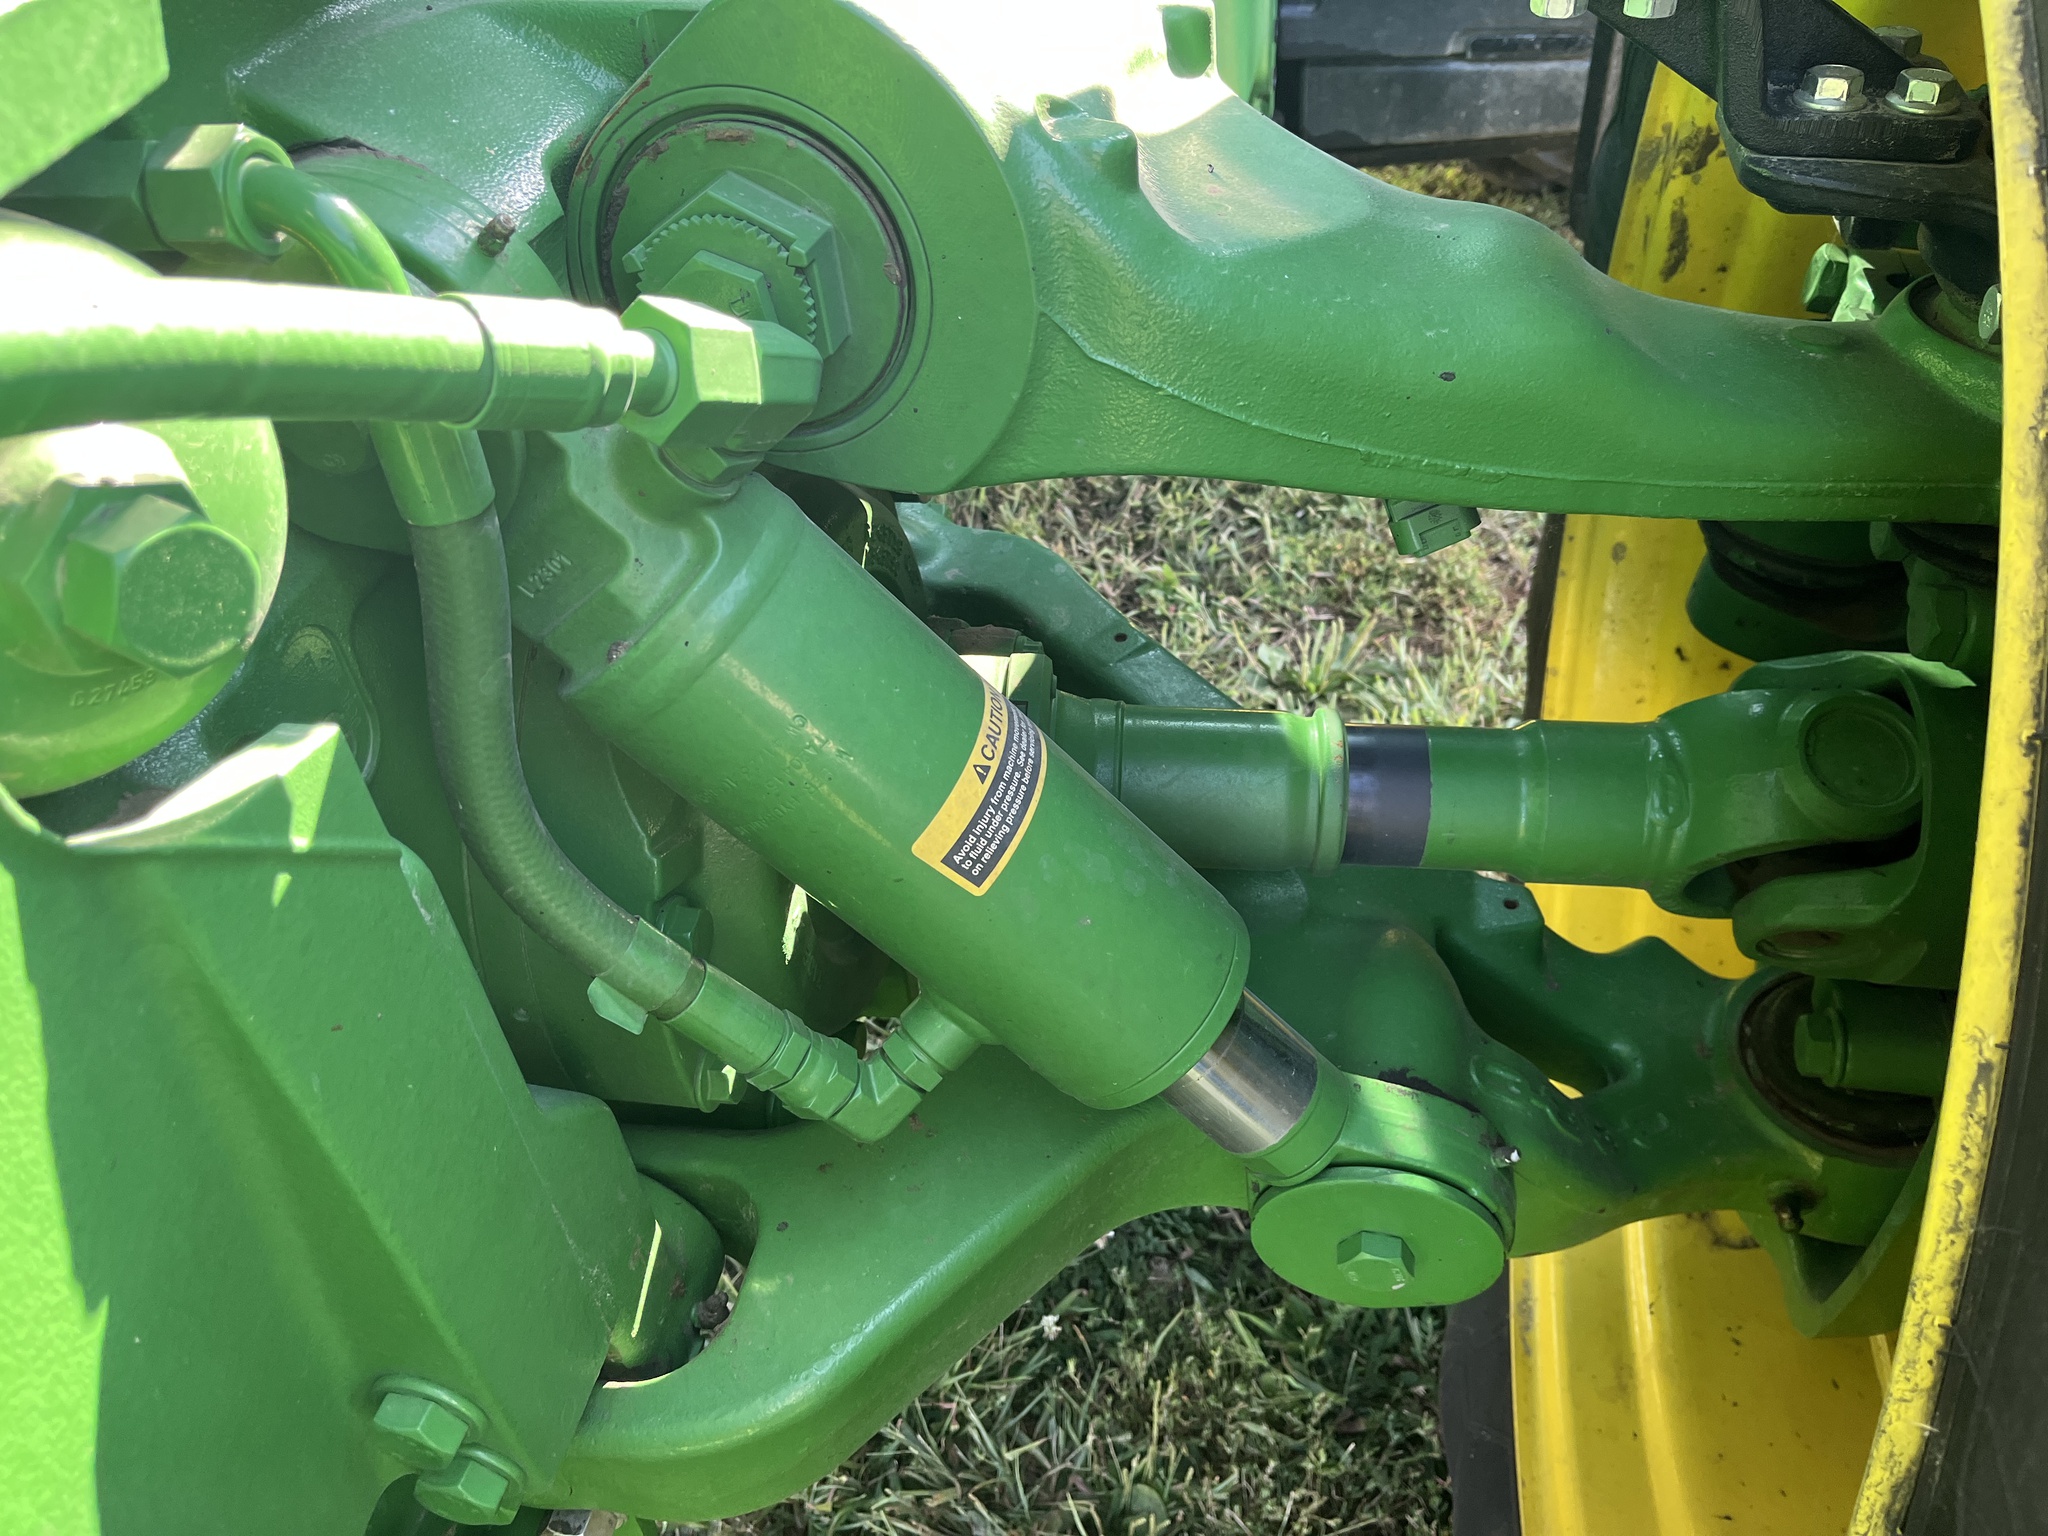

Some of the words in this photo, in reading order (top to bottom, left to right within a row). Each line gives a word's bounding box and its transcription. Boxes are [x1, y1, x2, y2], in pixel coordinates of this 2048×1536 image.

[981, 686, 1004, 762] CAUTION
[953, 834, 977, 865] Avoid
[972, 804, 996, 836] injury
[990, 781, 1007, 806] from
[1002, 742, 1019, 782] machine
[961, 858, 973, 871] to
[968, 837, 988, 860] fluid
[984, 810, 1004, 839] under
[1000, 770, 1022, 813] pressure.
[1016, 751, 1026, 768] See
[971, 862, 984, 877] on
[980, 823, 1011, 864] relieving
[1005, 784, 1028, 826] pressure
[1021, 757, 1035, 785] before
